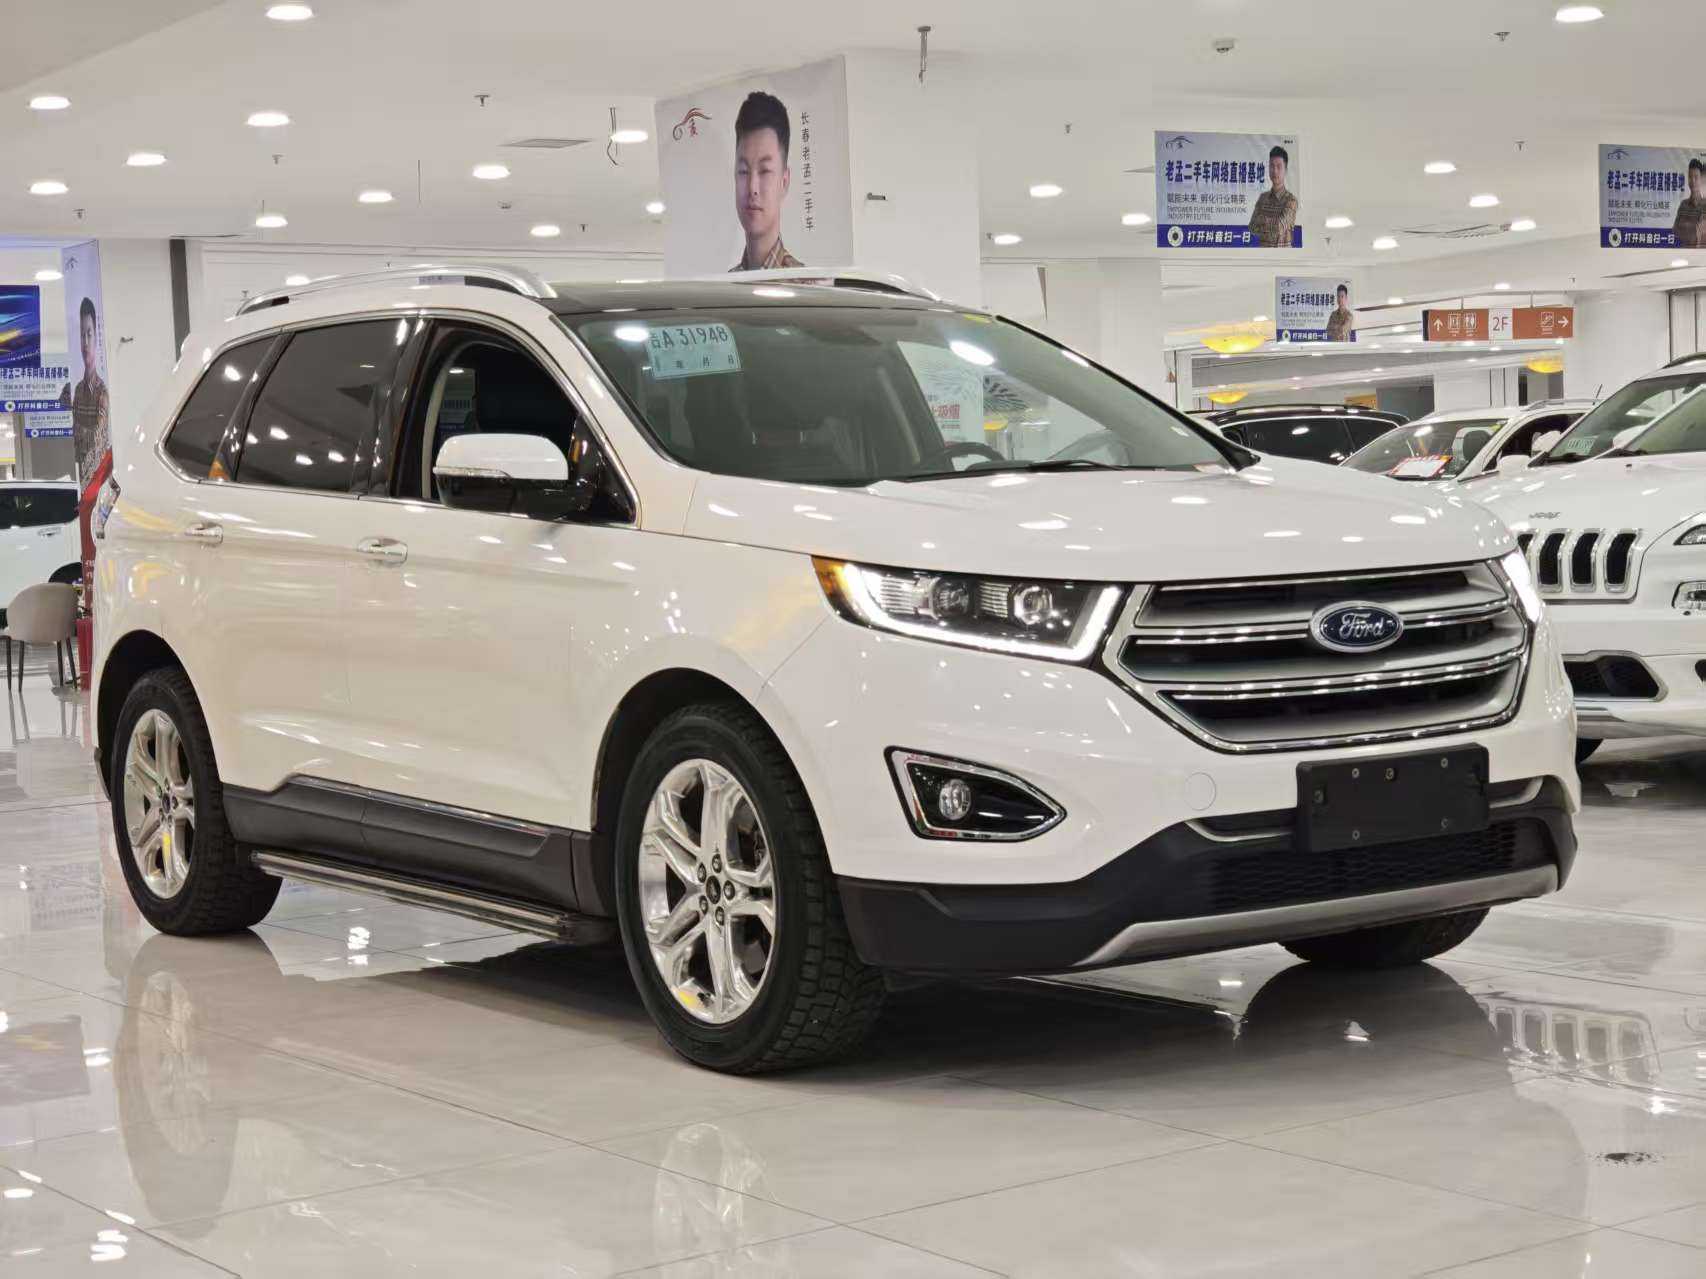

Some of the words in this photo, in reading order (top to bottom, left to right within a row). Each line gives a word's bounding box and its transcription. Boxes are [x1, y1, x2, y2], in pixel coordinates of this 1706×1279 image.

[801, 111, 814, 231] 长春老孟二手车
[1166, 160, 1265, 183] 老孟二手车网络直播基地
[1187, 230, 1251, 243] 打开抖音扫一扫
[1492, 316, 1508, 331] 2F
[1339, 612, 1385, 638] Ford
